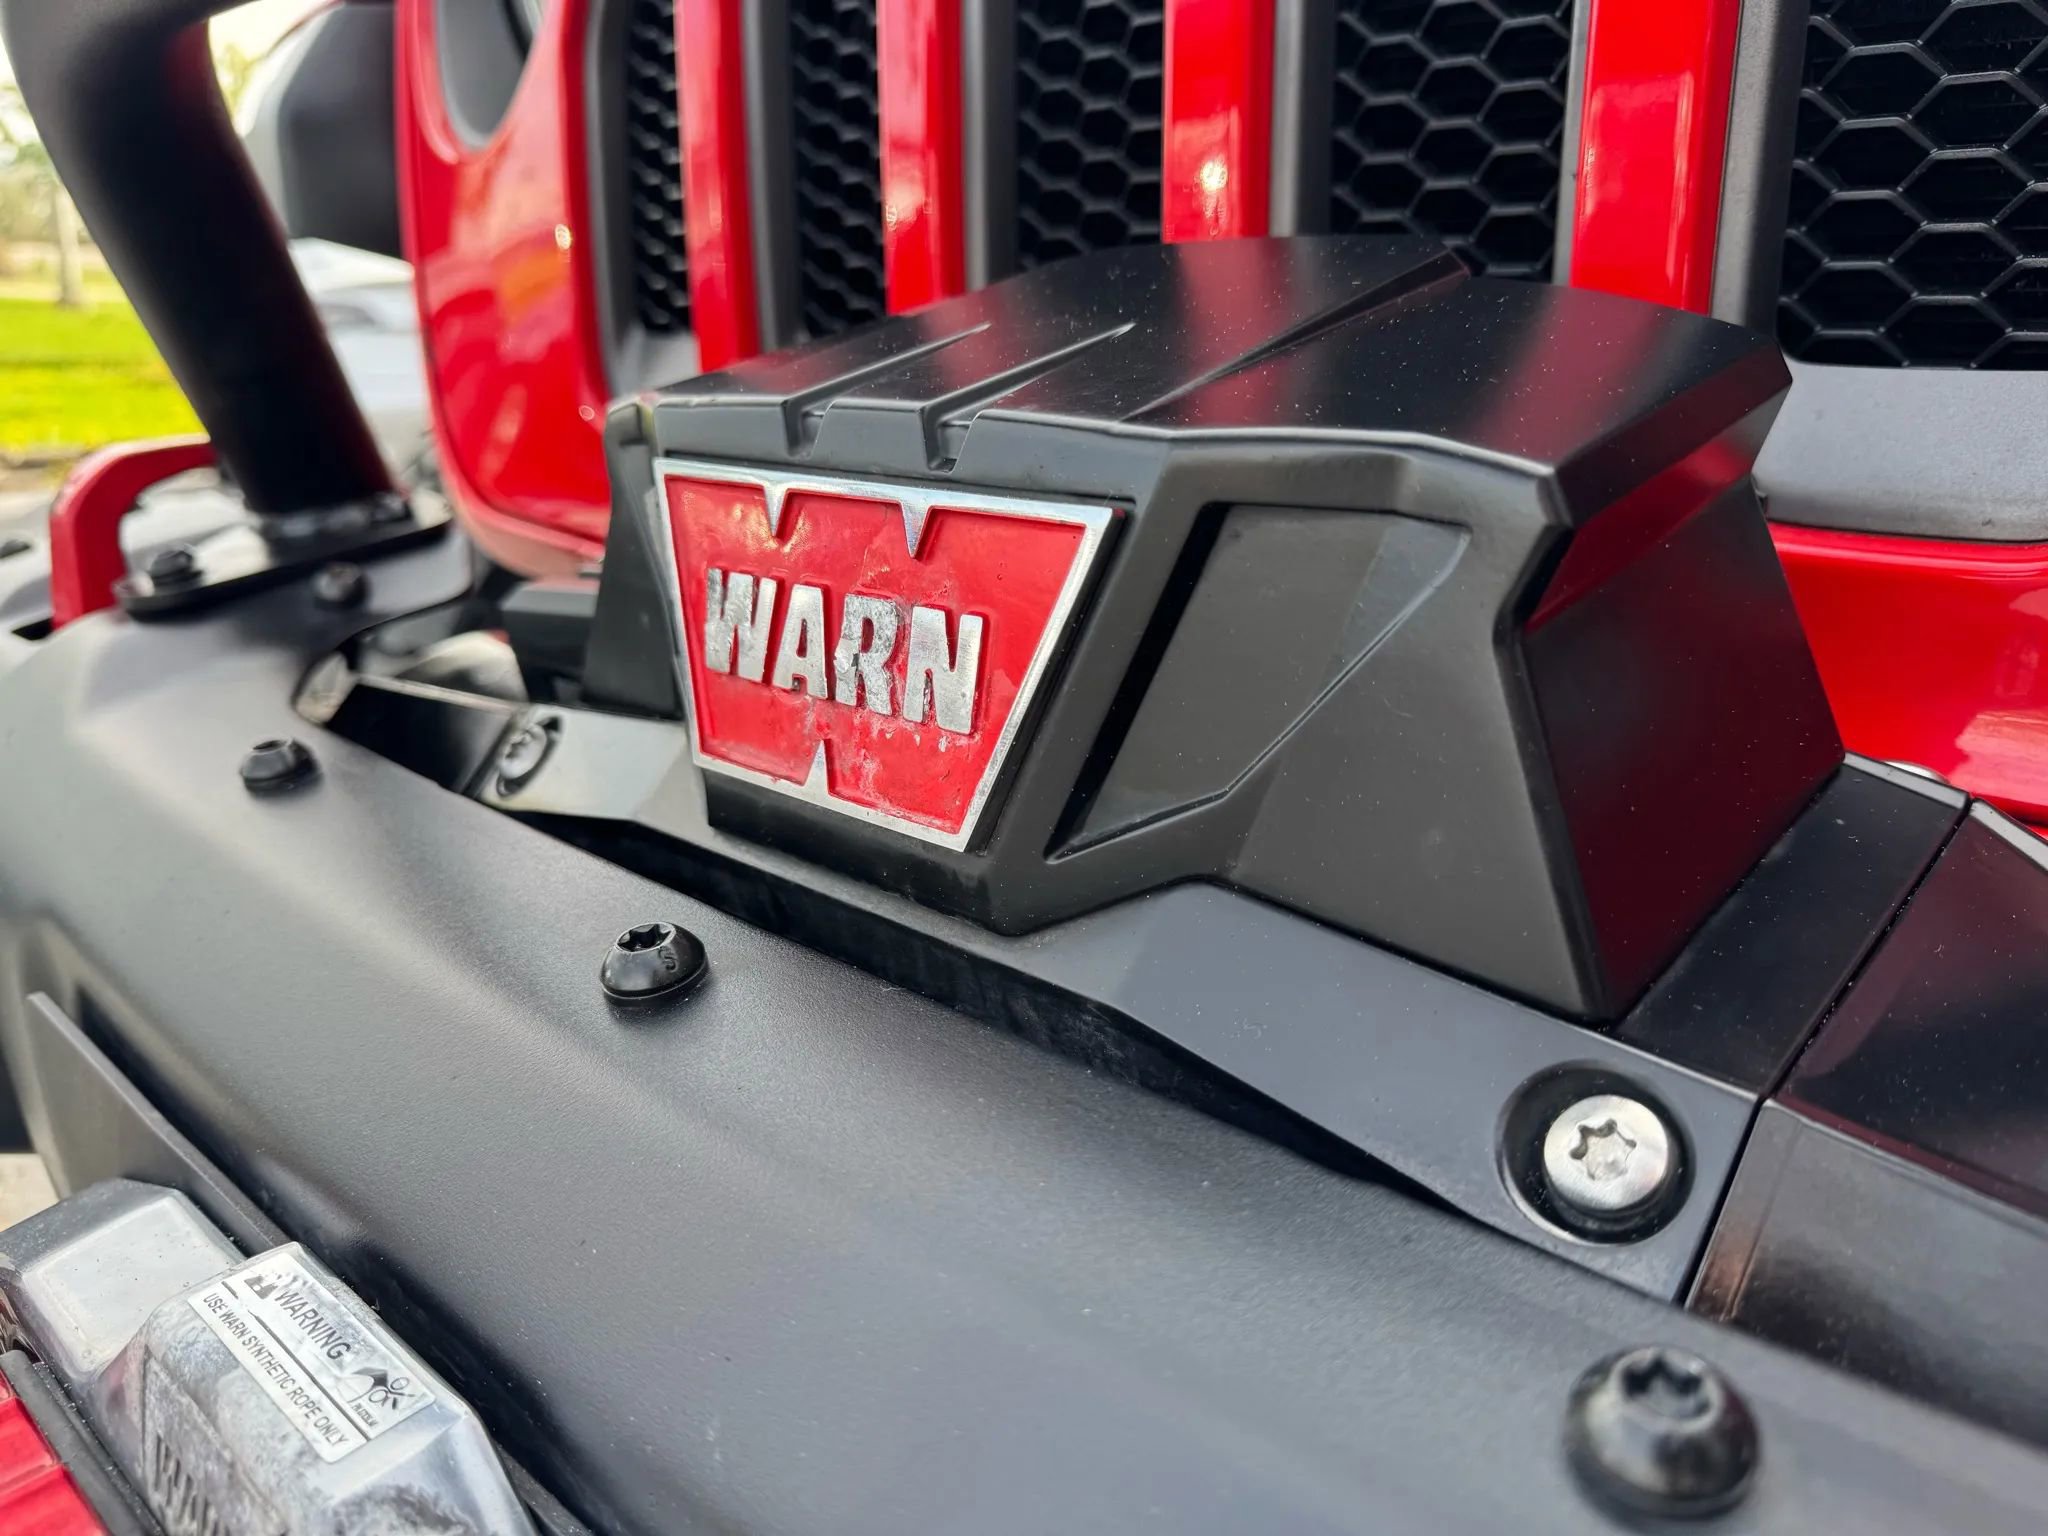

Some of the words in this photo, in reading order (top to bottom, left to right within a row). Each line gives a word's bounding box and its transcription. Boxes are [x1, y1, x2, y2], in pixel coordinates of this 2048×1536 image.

[705, 567, 982, 734] WARN
[203, 1293, 228, 1314] USE
[219, 1309, 252, 1339] WARN
[241, 1335, 296, 1389] SYNTHETIC
[286, 1386, 322, 1419] ROPE
[313, 1416, 349, 1446] ONLY
[274, 1290, 351, 1360] WARNING
